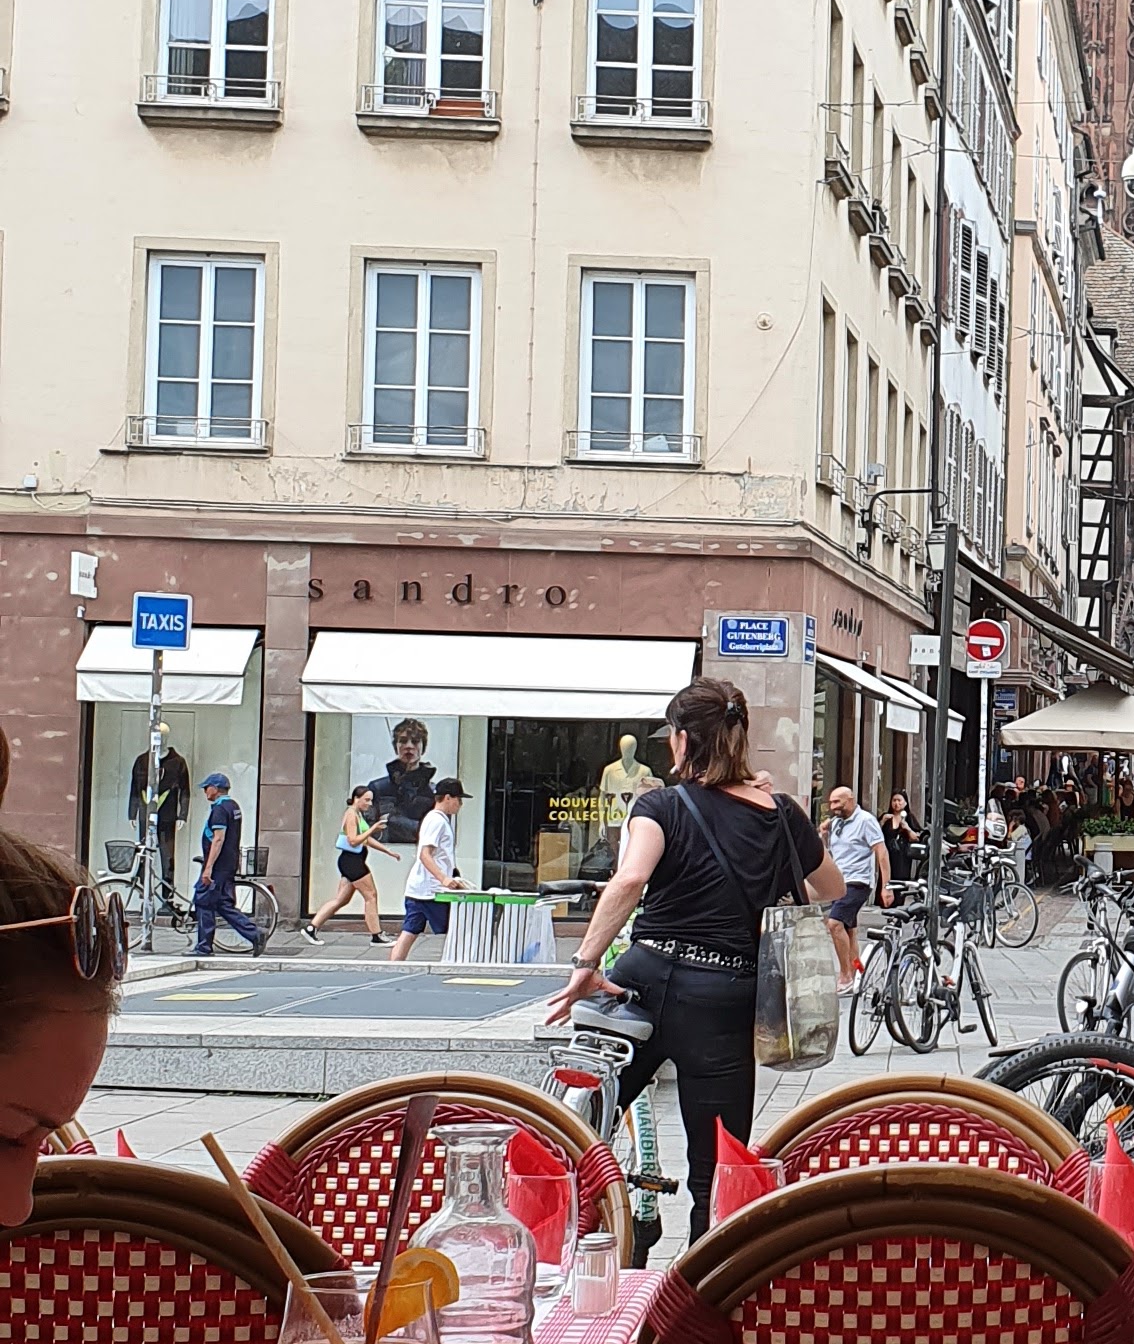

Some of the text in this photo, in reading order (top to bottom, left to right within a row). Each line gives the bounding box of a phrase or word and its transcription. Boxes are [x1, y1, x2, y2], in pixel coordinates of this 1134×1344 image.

[307, 573, 567, 606] sandro
[139, 612, 185, 632] TAXIS
[739, 621, 769, 630] PLACE
[726, 632, 782, 641] GUTENBERG
